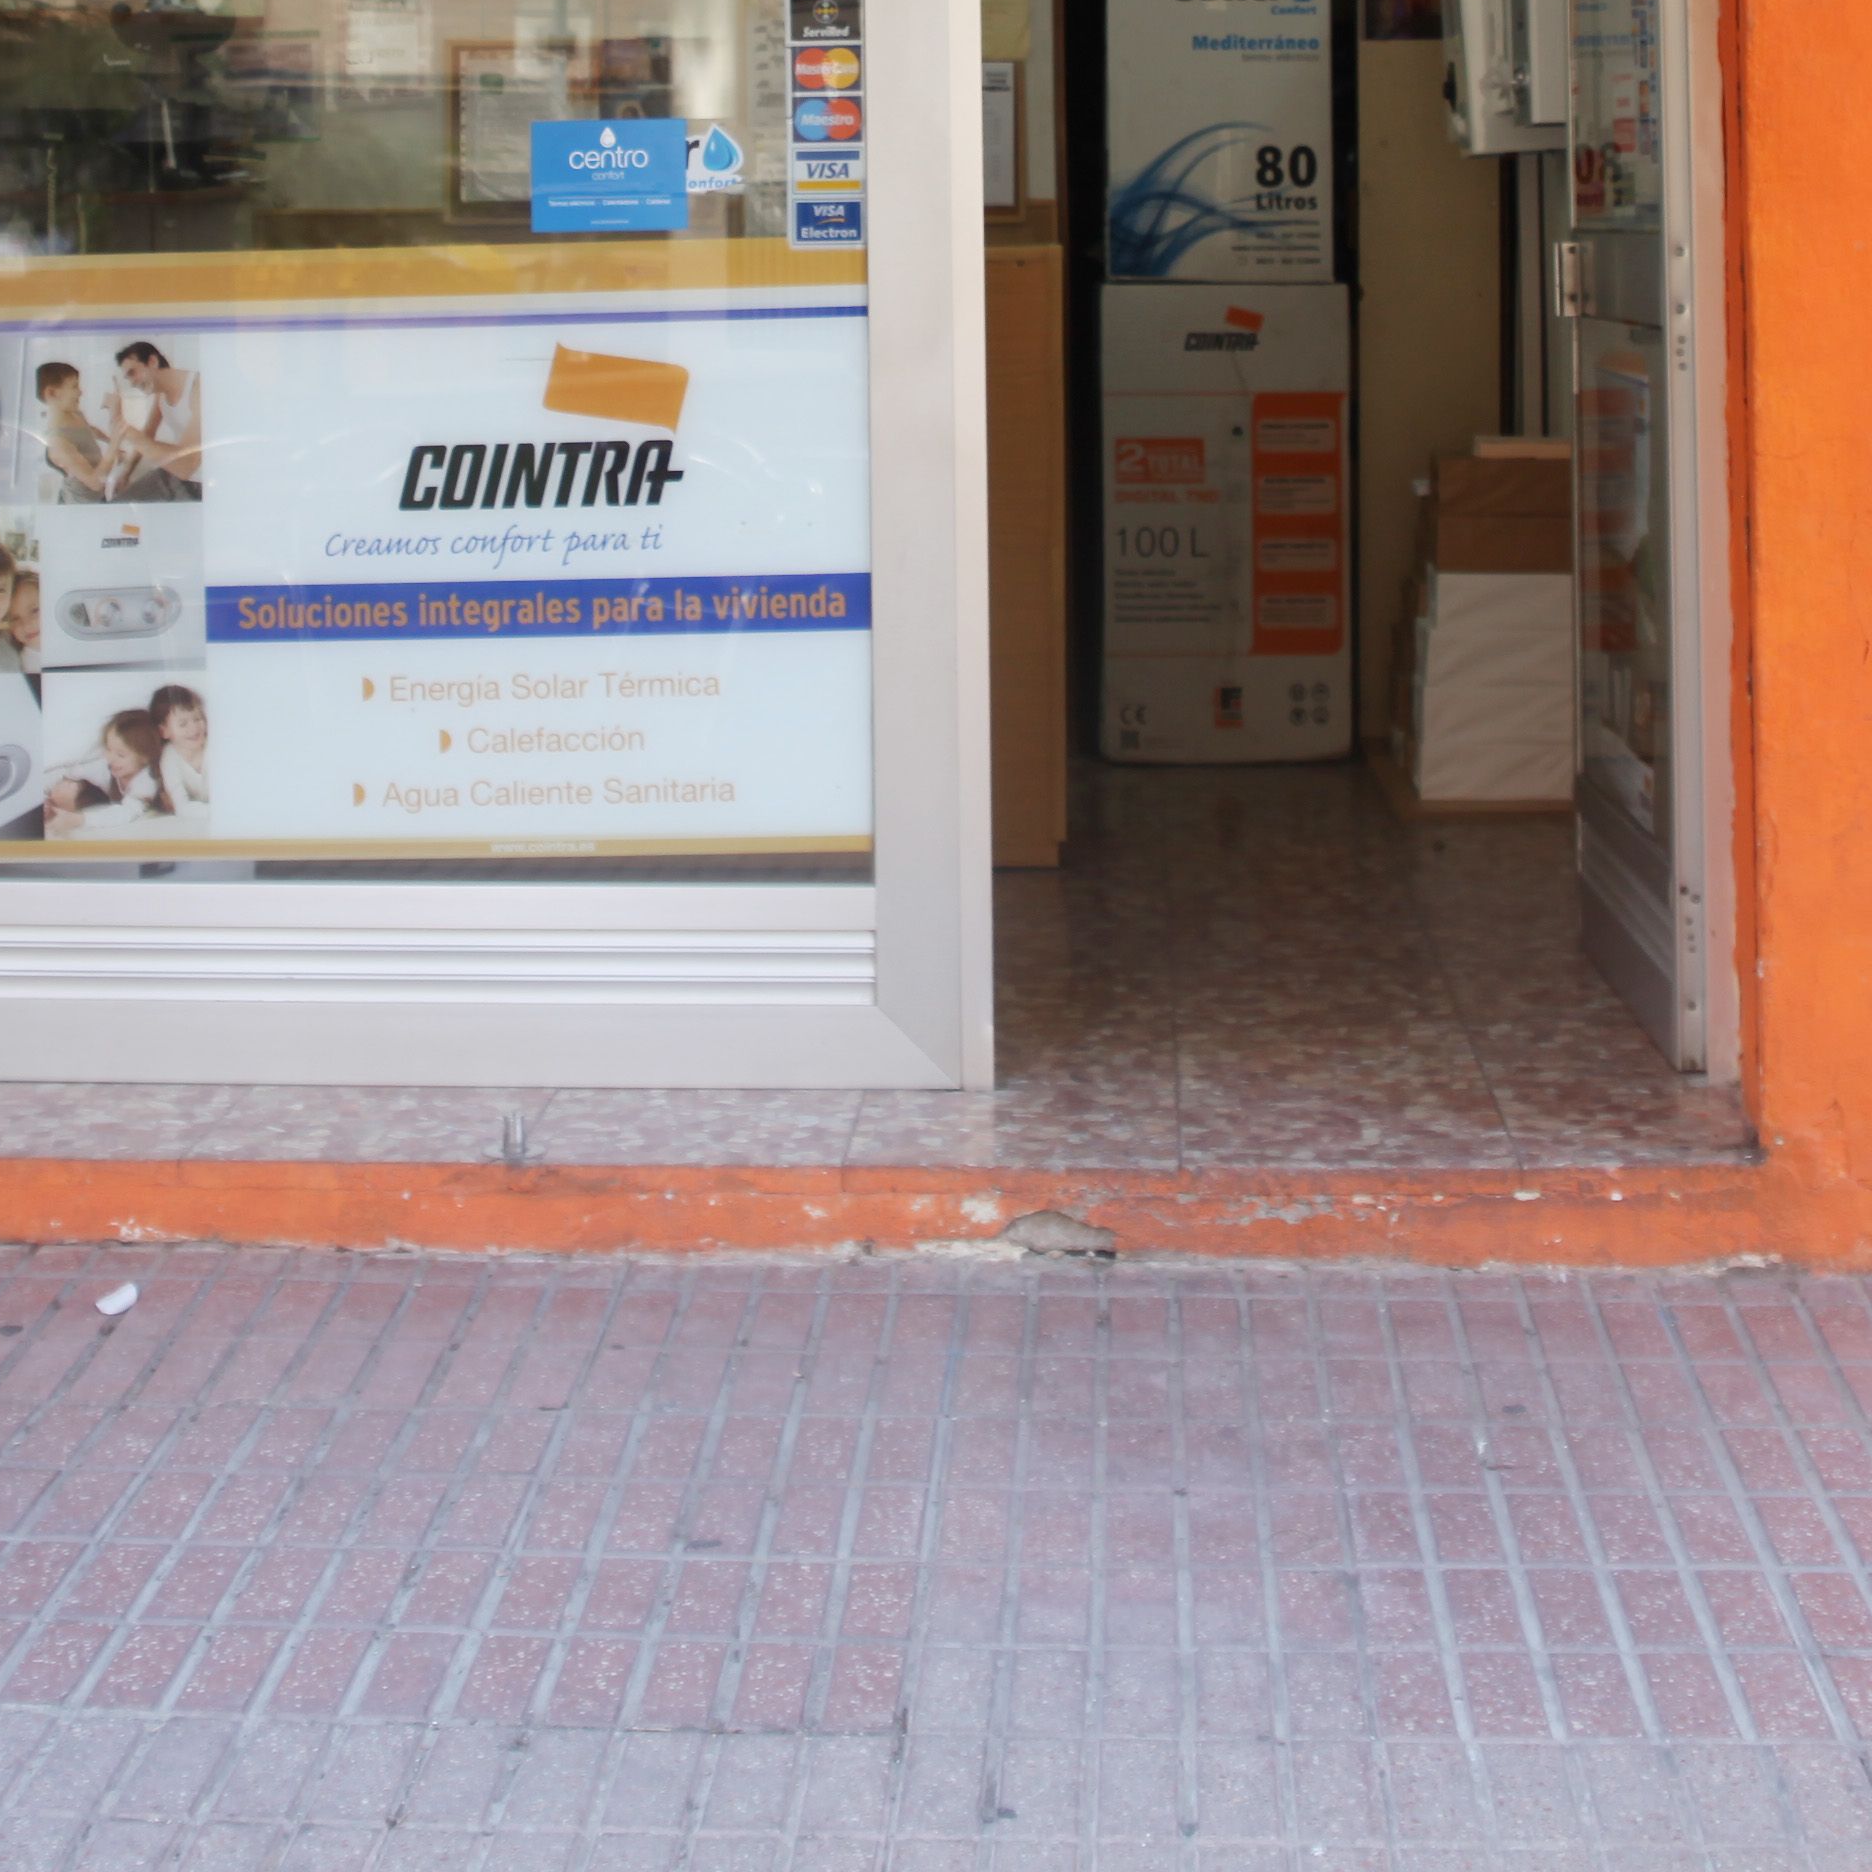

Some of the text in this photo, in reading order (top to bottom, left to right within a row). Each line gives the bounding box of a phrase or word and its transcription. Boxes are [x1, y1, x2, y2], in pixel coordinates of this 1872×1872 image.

[1191, 33, 1320, 52] Mediterráneo
[800, 113, 854, 127] Maestro
[568, 143, 648, 170] centro
[806, 162, 850, 179] VISA
[1255, 143, 1318, 189] 80
[813, 205, 845, 217] VISA
[1255, 191, 1318, 212] Litros
[801, 227, 857, 239] Electron
[1184, 331, 1261, 352] COINTRA
[1117, 443, 1145, 473] 2
[399, 439, 684, 511] COINTRA
[325, 524, 664, 569] Creamos confort para ti
[1117, 526, 1210, 559] 100 L
[238, 586, 848, 632] Soluciones integrales para la vivienda
[389, 669, 721, 707] Energía Solar Térmica
[466, 726, 646, 755] Calefacción
[382, 774, 736, 813] Agua Caliente Sanitaria
